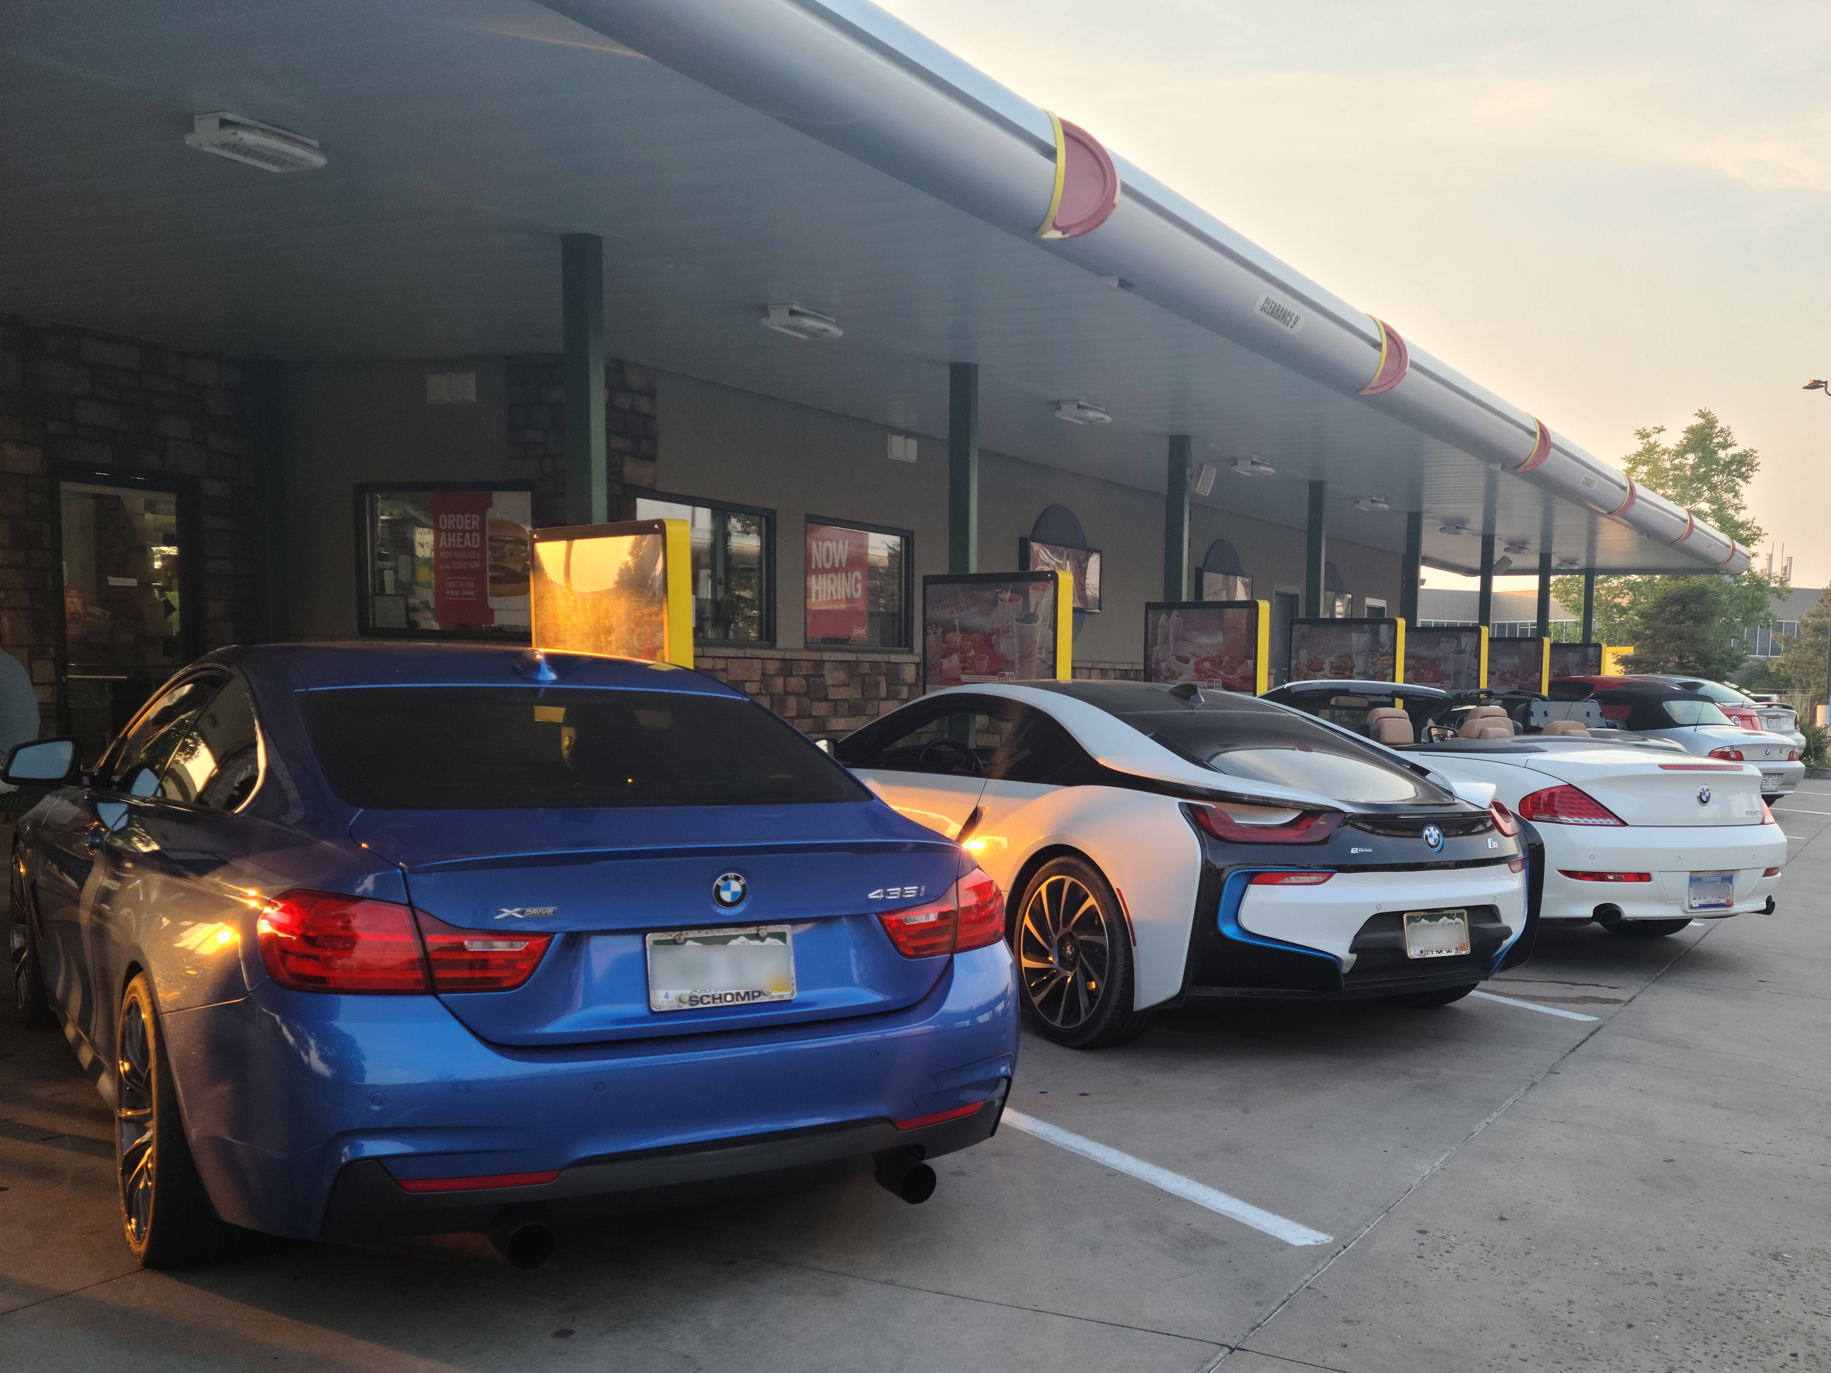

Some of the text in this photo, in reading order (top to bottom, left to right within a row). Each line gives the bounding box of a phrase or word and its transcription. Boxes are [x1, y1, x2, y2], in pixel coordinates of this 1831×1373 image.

[1260, 296, 1295, 327] CLEARANCE
[439, 513, 480, 530] ORDER
[439, 532, 480, 548] AHEAD
[439, 550, 481, 558] NOW AVAILABLE
[811, 540, 849, 569] NOW
[469, 561, 481, 569] APP
[811, 571, 862, 602] HIRING
[1018, 649, 1034, 664] SONIC
[867, 885, 926, 900] 435i
[689, 990, 762, 1007] SCHOMP
